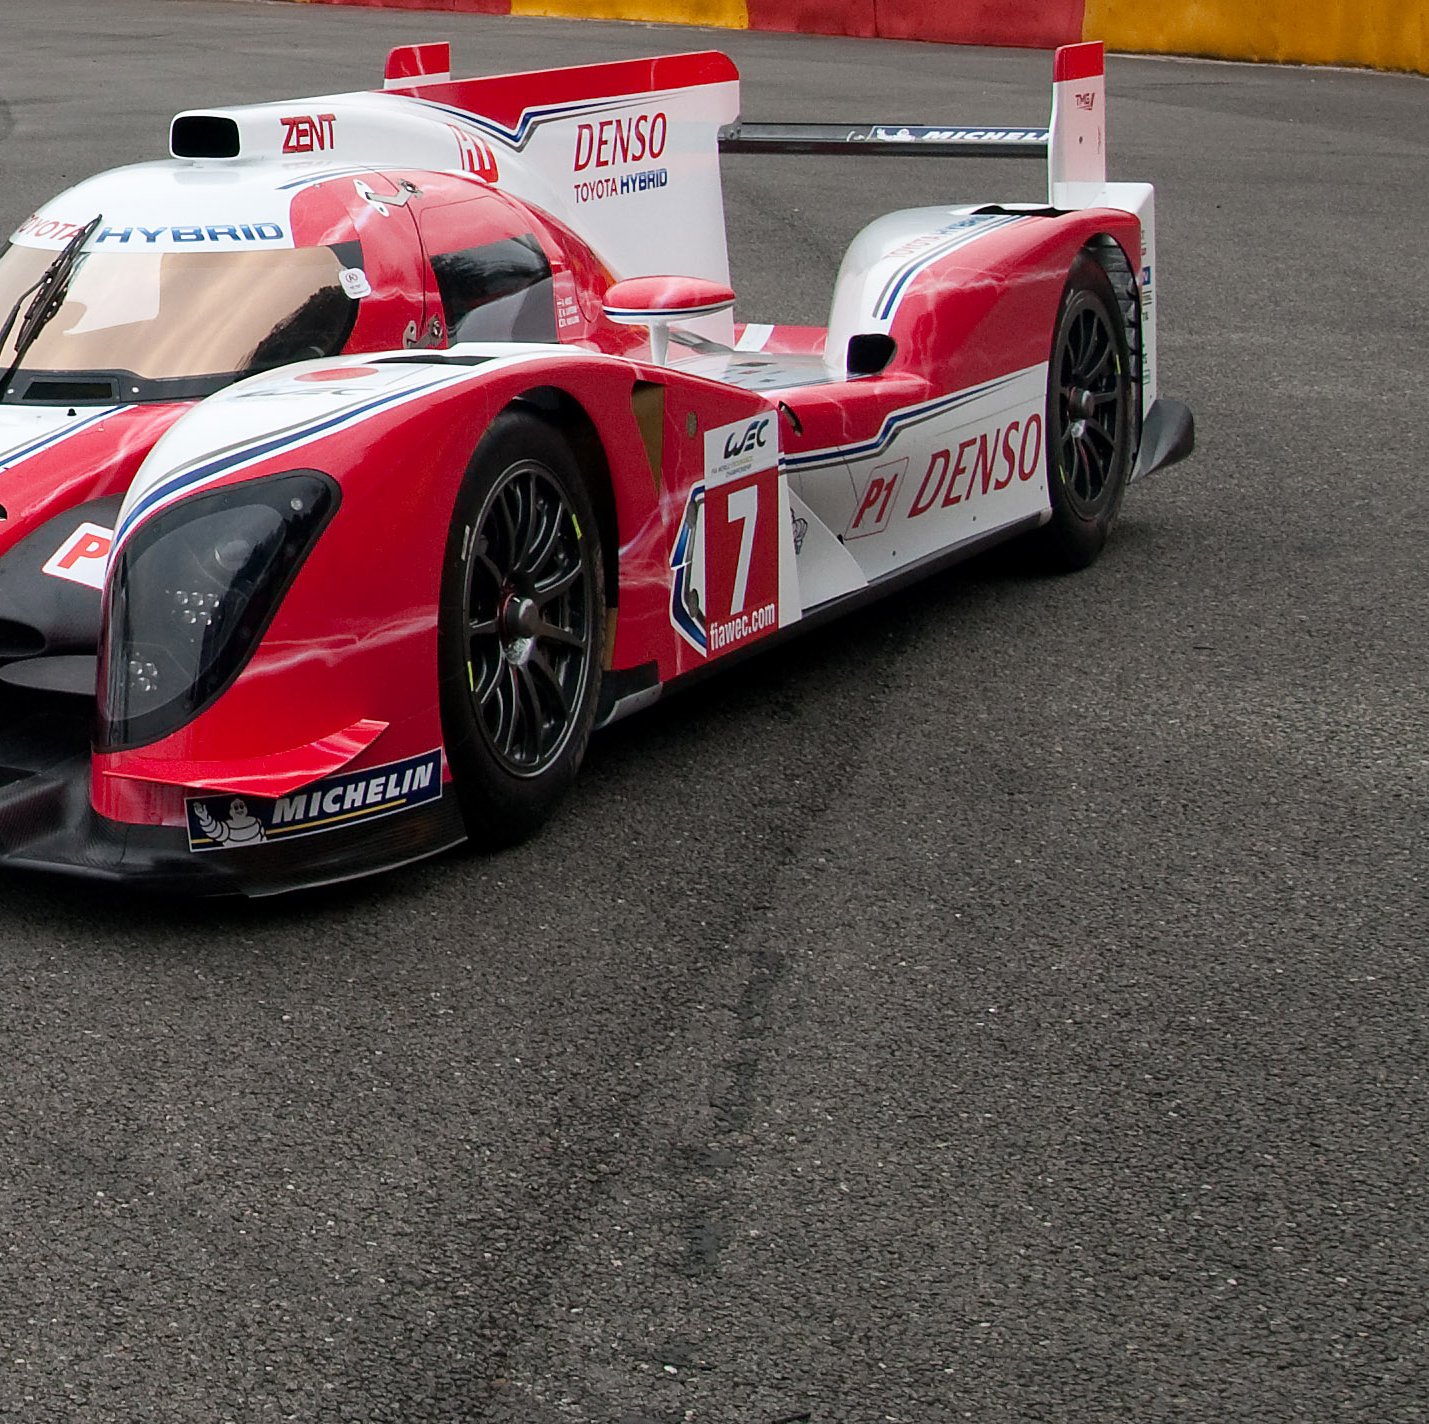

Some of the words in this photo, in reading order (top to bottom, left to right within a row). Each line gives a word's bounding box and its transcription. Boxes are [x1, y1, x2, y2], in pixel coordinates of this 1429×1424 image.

[279, 113, 337, 154] ZENT
[574, 112, 667, 172] DENSO
[574, 178, 618, 203] TOYOTA
[620, 168, 668, 195] HYBRID
[96, 223, 284, 243] HYBRID
[724, 418, 769, 459] WEC
[852, 473, 898, 529] P1
[907, 413, 1042, 519] DENSO
[728, 484, 758, 616] 7
[710, 603, 776, 651] fiawec.com
[271, 762, 434, 824] MICHELIN
